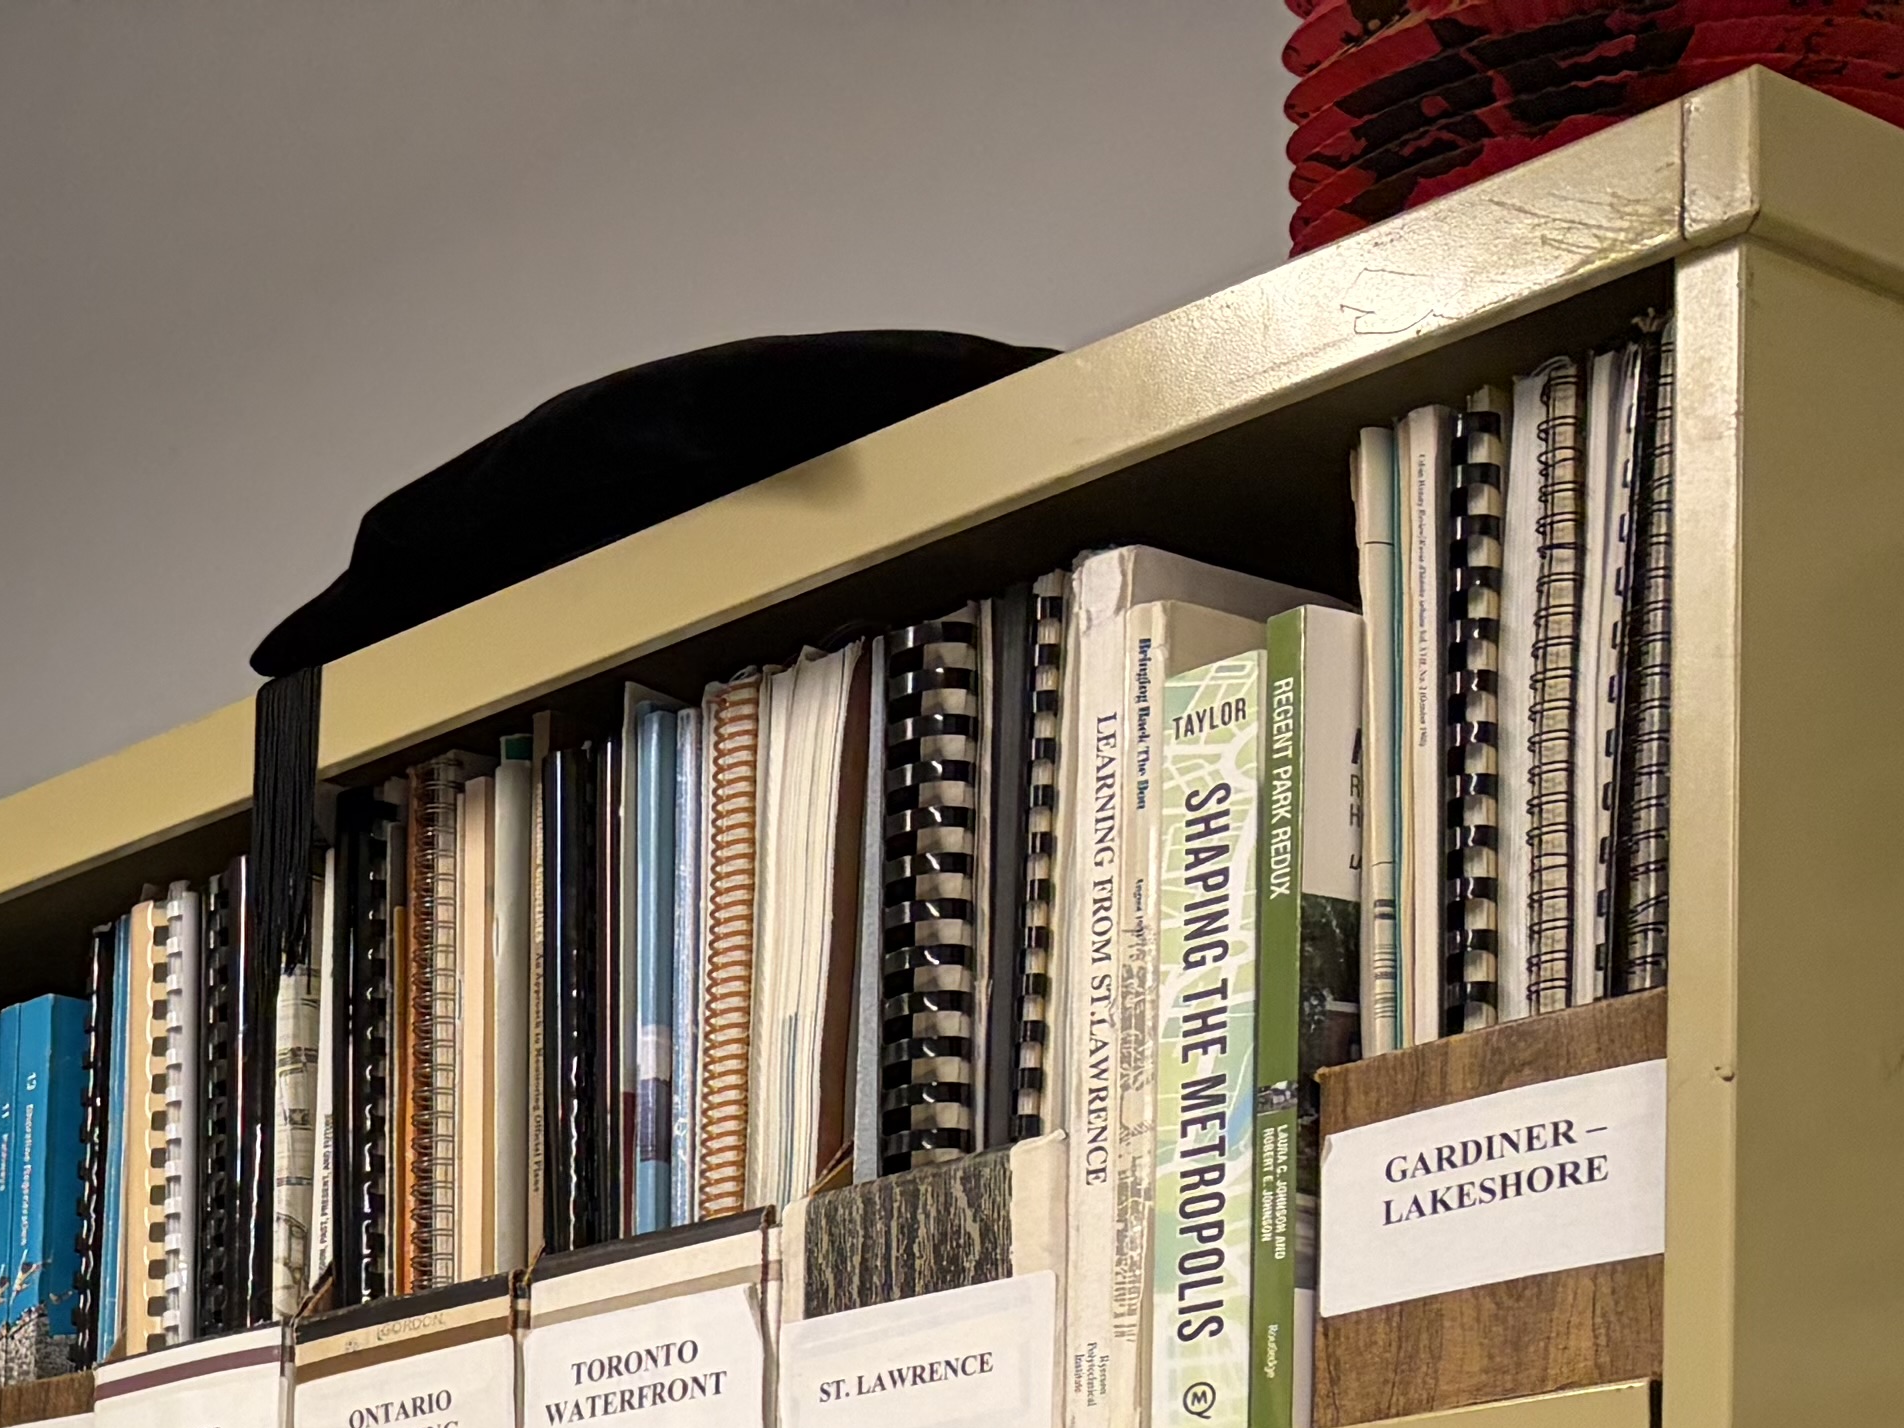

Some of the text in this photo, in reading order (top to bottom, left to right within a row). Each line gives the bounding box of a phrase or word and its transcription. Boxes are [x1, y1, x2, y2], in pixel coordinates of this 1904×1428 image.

[1171, 698, 1248, 741] TAYLOR
[1176, 782, 1230, 1343] SHAPING THE METROPOLIS
[1384, 1119, 1577, 1182] GARDINER
[1382, 1153, 1610, 1226] LAKESHORE
[571, 1338, 699, 1386] TORONTO
[818, 1352, 995, 1403] ST. LAWRENCE
[545, 1371, 728, 1428] WATERFRONT
